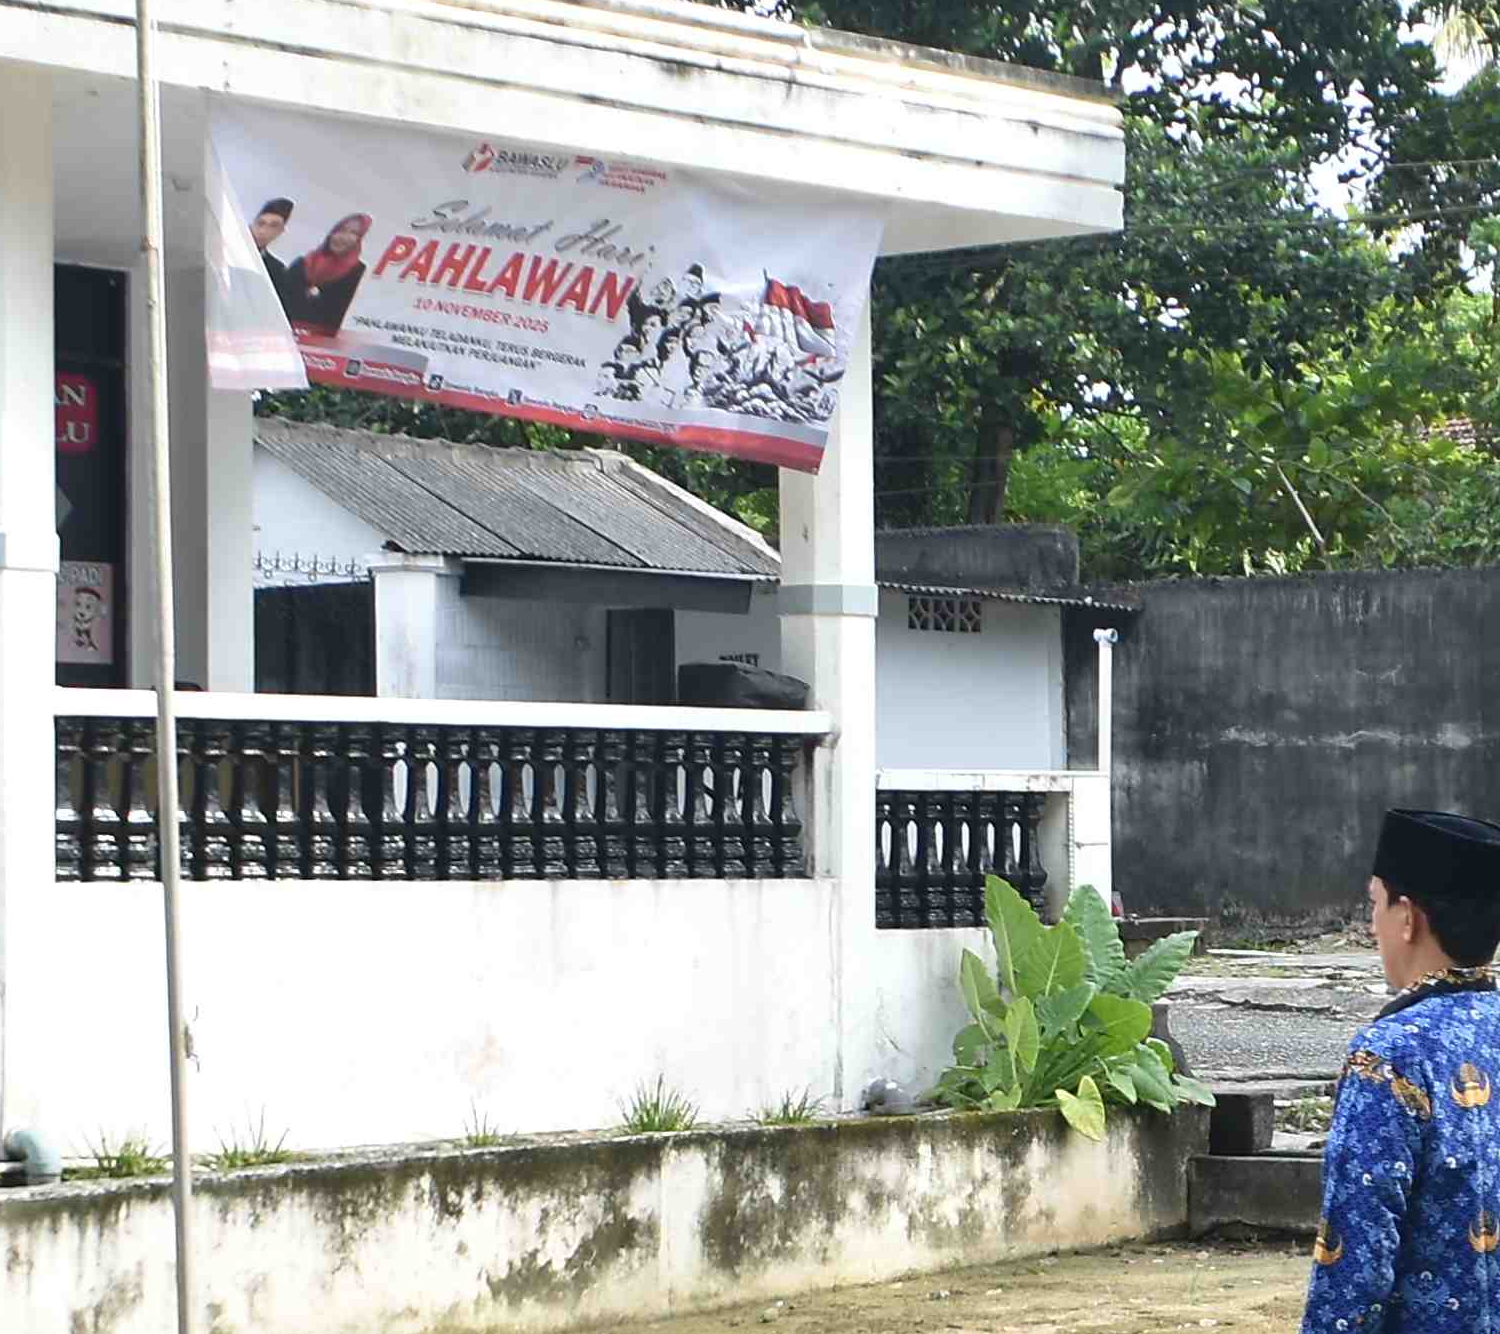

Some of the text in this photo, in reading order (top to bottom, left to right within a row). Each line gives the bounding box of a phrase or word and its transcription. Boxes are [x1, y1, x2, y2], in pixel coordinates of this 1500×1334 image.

[410, 200, 554, 243] Selamat
[373, 234, 635, 323] PAHLAWAN
[412, 298, 550, 333] 10 NOVEMBER 2025
